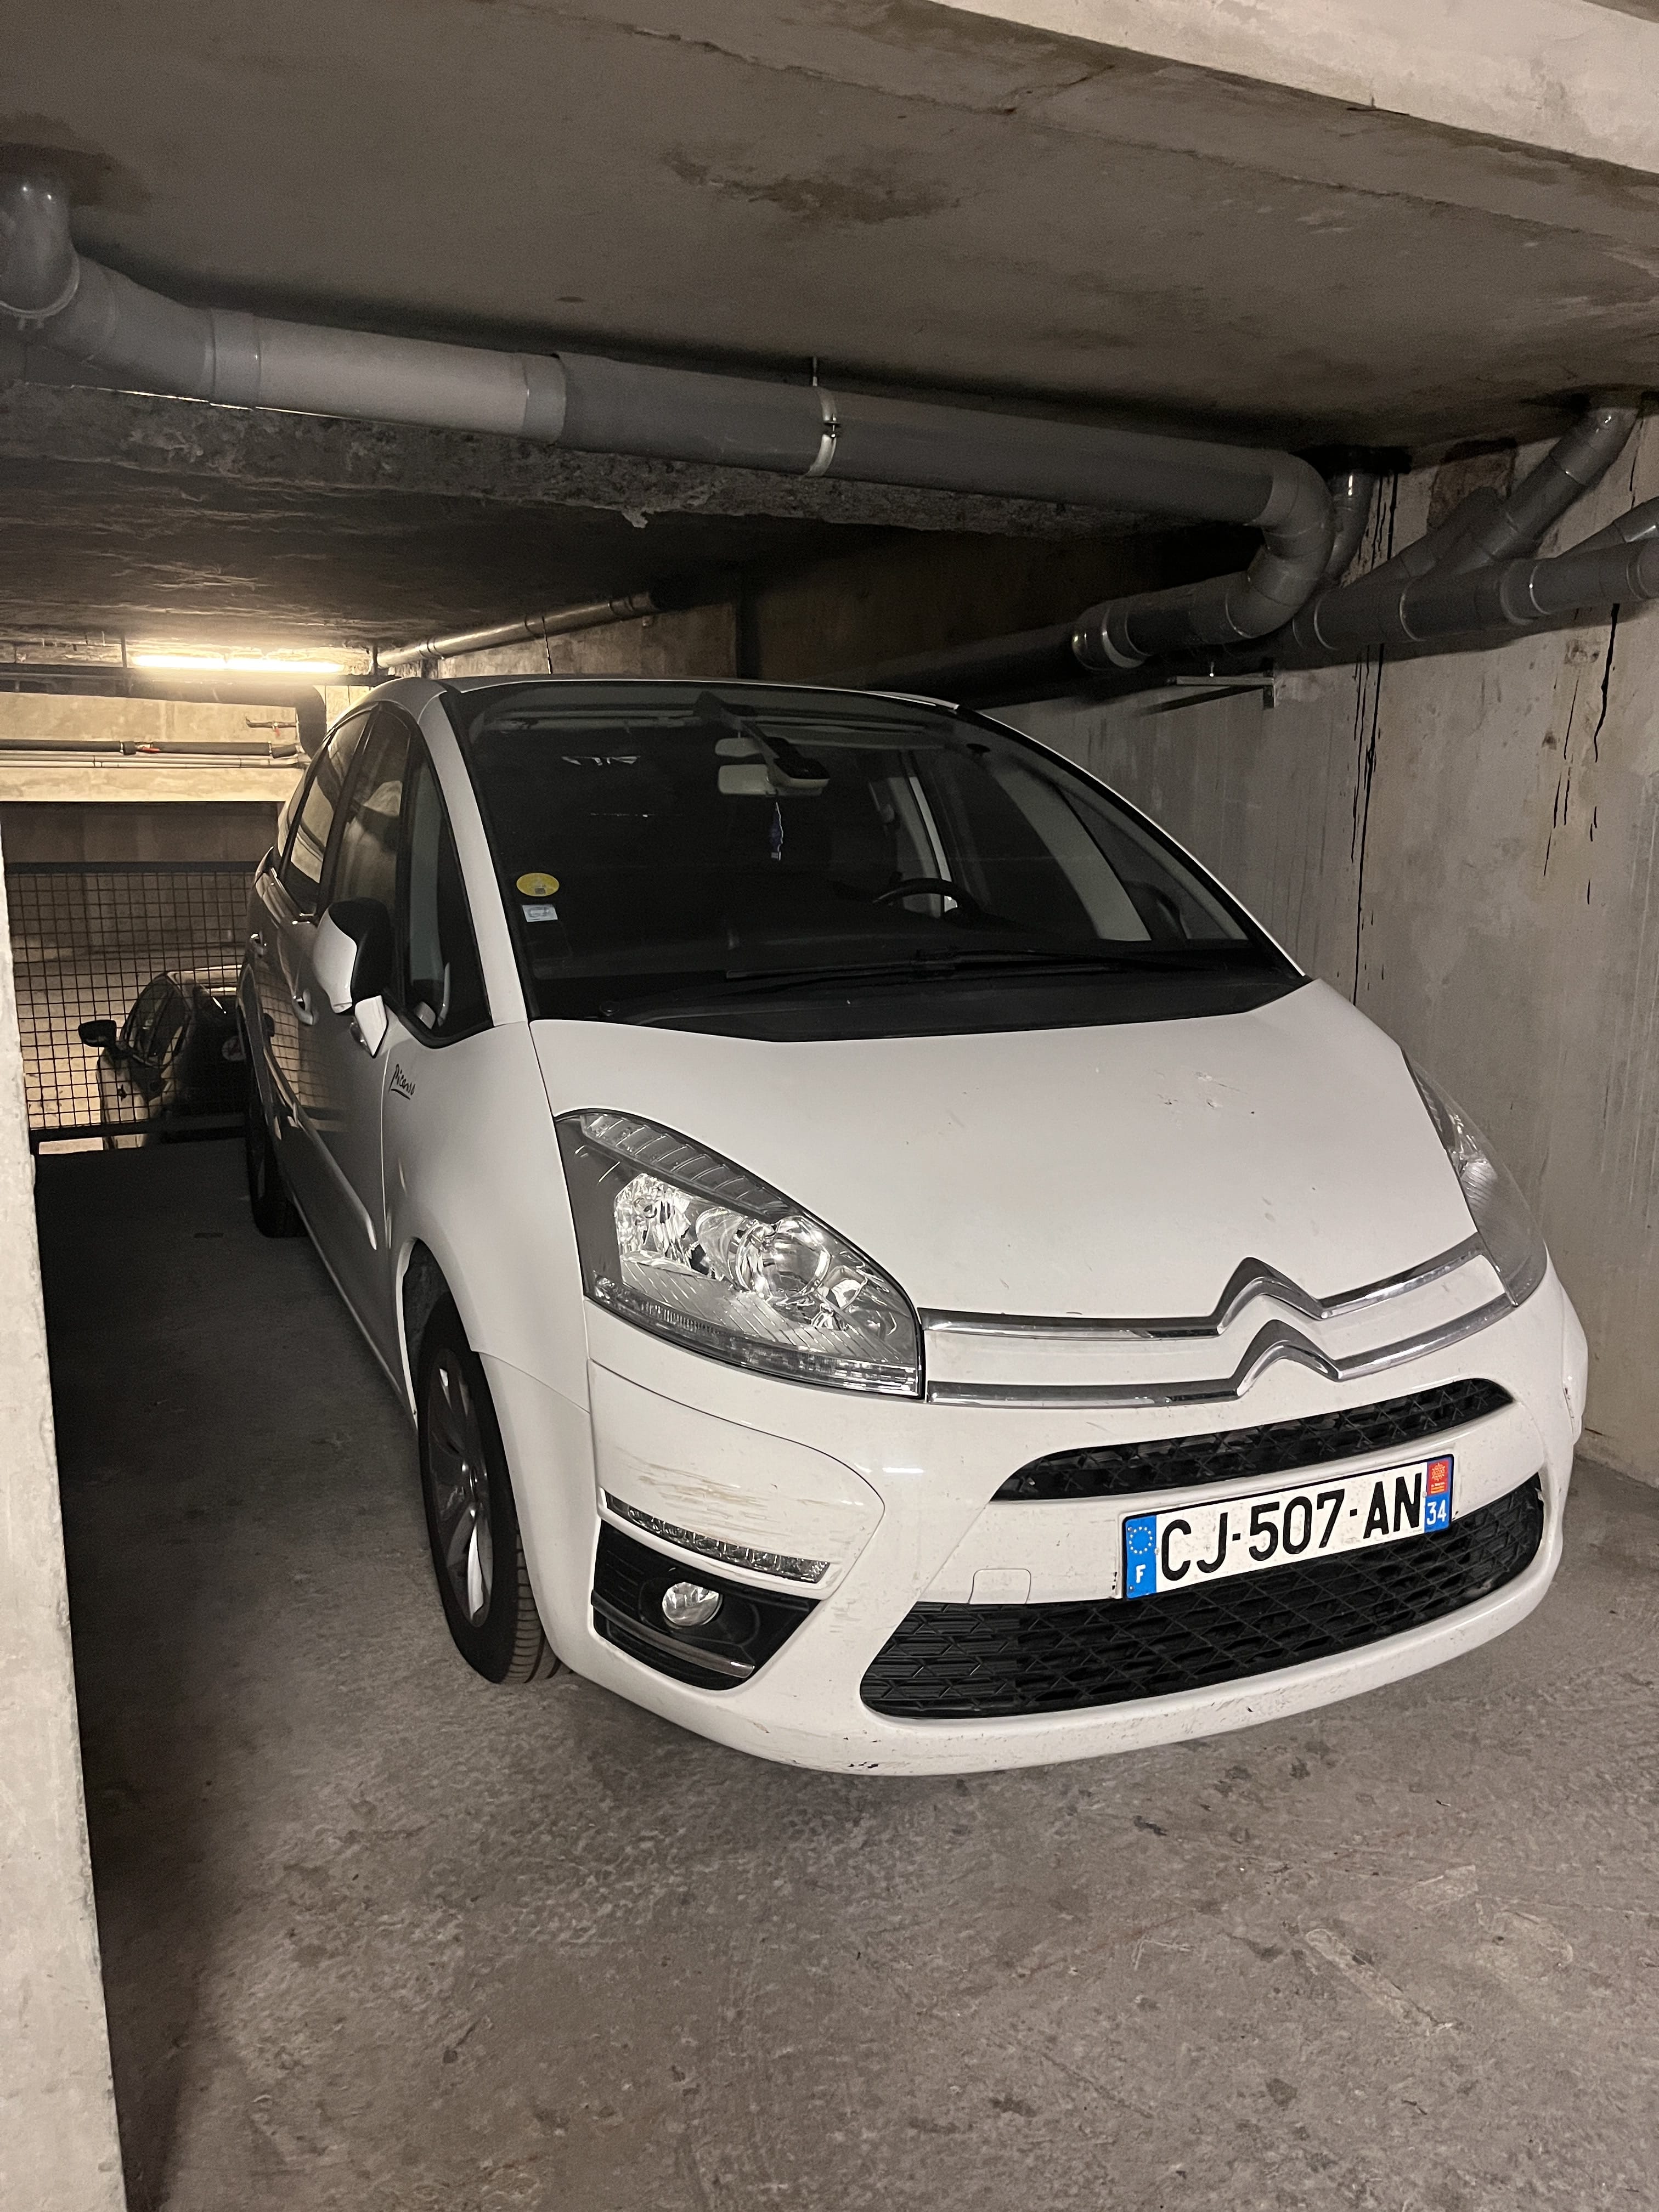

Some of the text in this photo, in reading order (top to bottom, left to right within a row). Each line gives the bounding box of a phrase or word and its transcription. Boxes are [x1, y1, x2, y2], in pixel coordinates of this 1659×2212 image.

[1426, 1499, 1447, 1525] 34
[1161, 1472, 1422, 1581] CJ-507-AN
[1136, 1564, 1146, 1583] F
